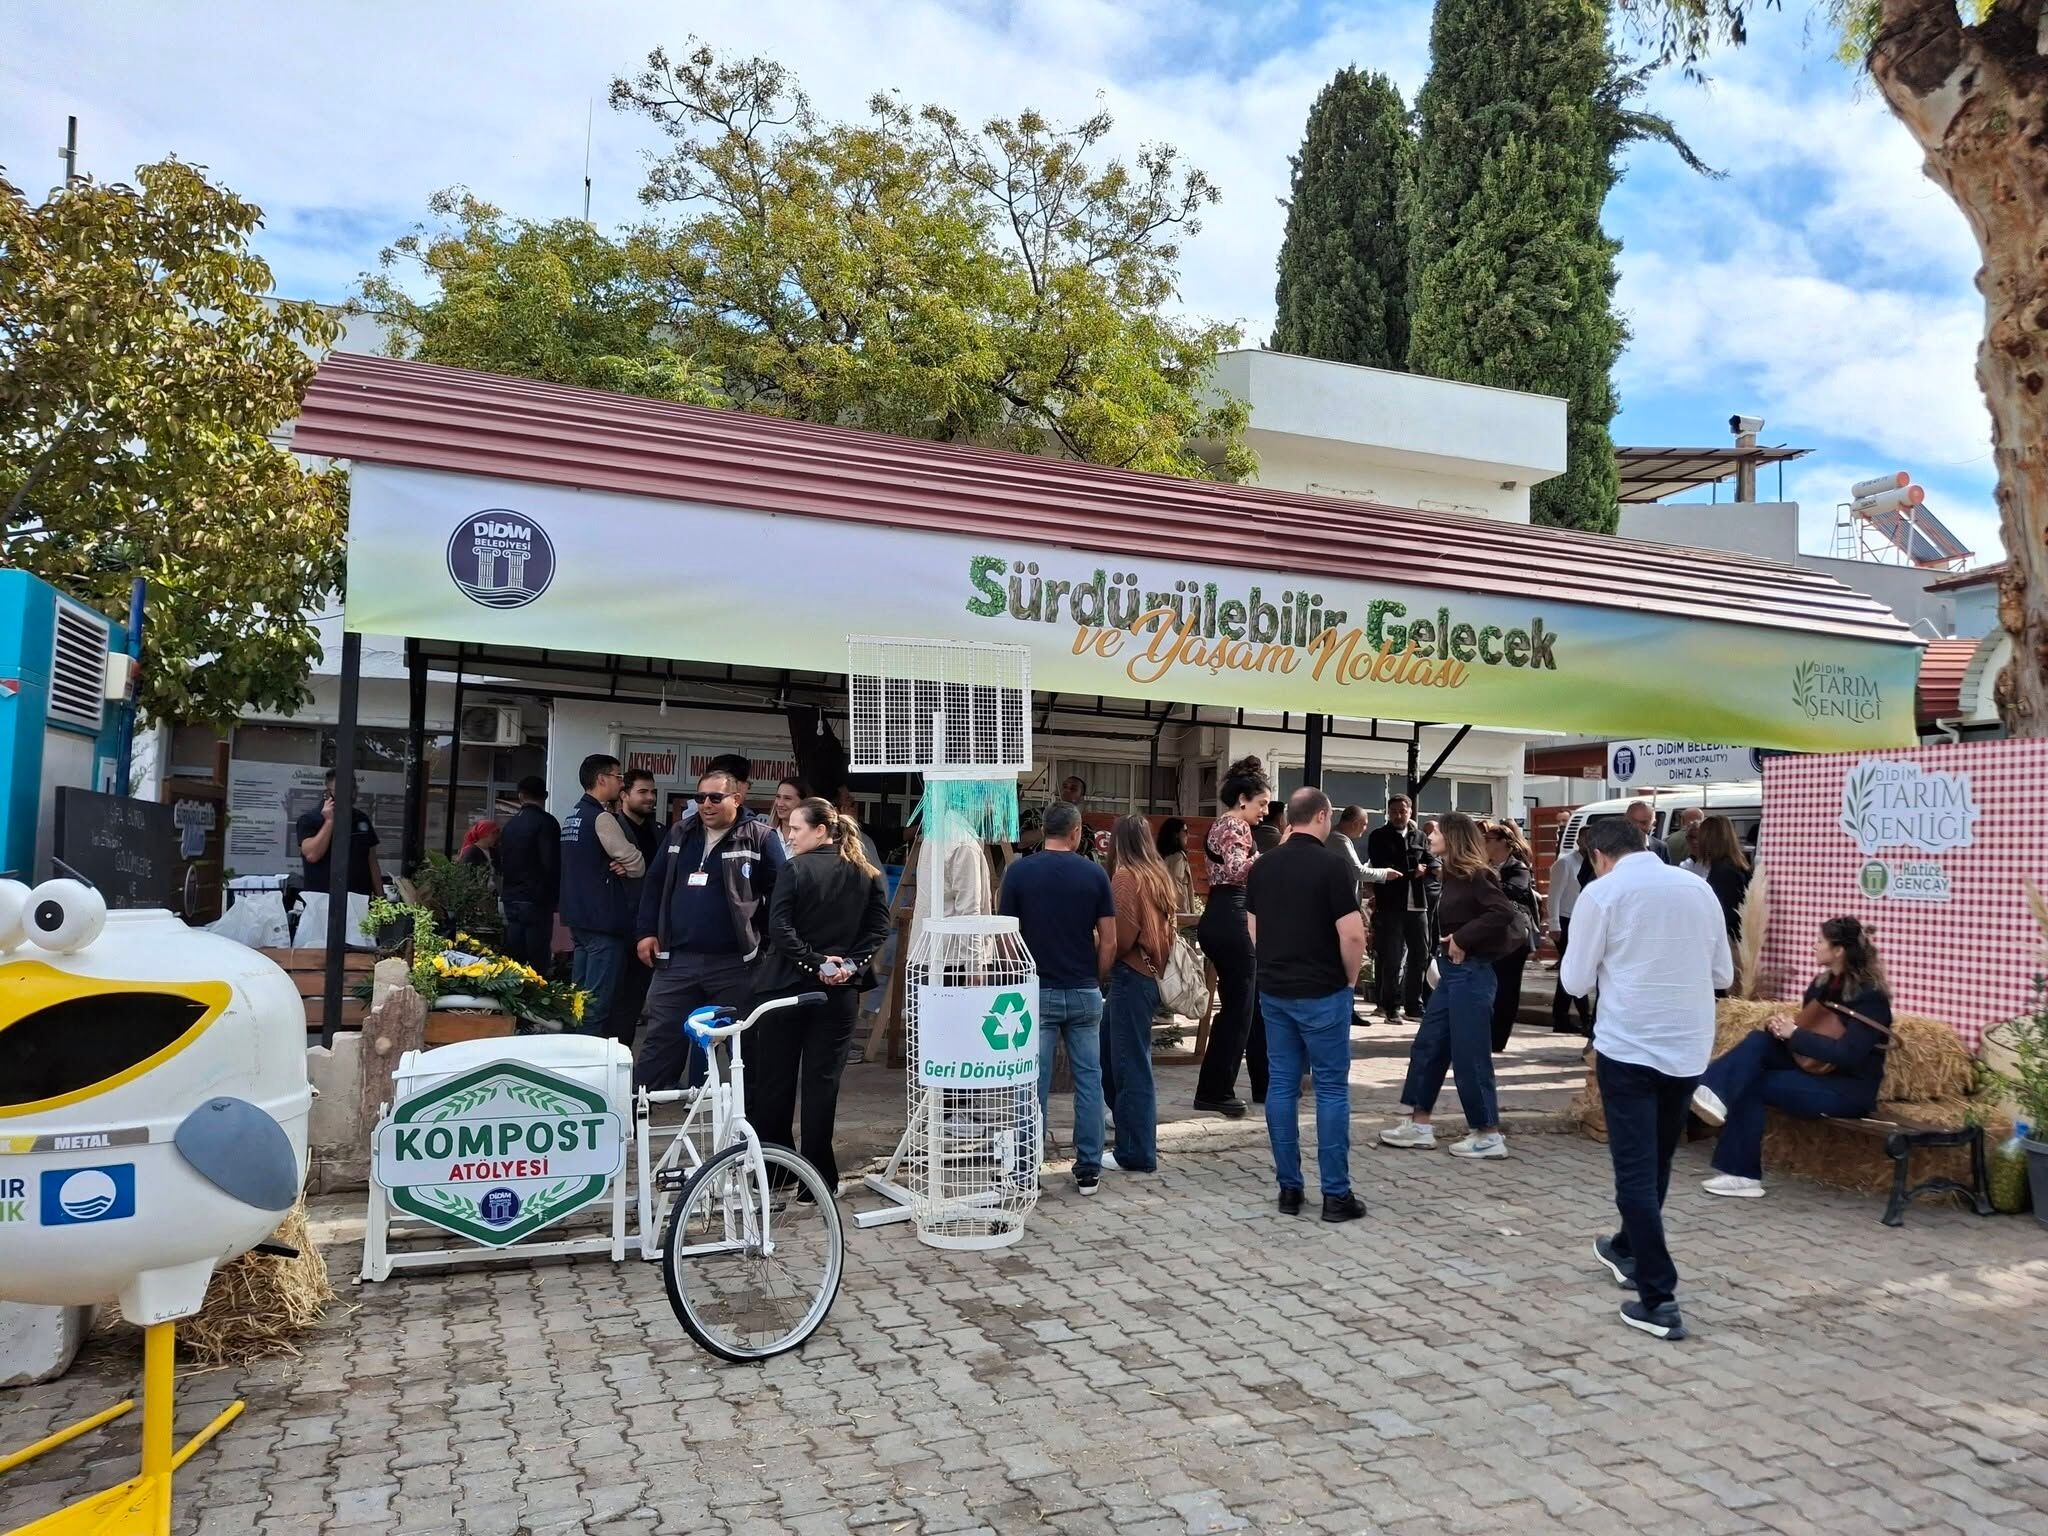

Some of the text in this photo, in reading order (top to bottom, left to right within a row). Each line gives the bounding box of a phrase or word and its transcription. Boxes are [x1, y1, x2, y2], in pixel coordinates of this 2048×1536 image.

[473, 521, 531, 541] DİDİM
[474, 537, 531, 551] BELEDİYESİ
[966, 554, 1558, 671] Sürdürülebilir Gelecek
[1071, 607, 1470, 689] ve Yaşam Noktası
[1815, 673, 1884, 703] TARIM
[1808, 695, 1881, 723] ŞENLİĞİ
[1639, 745, 1655, 757] T.C.
[1657, 742, 1685, 756] DİDİM
[1694, 766, 1712, 779] A.Ş.
[1875, 768, 1917, 781] DİDİM
[1875, 777, 1973, 813] TARIM
[1864, 812, 1968, 847] ŞENLİĞİ
[924, 1059, 956, 1078] Geri
[959, 1057, 1033, 1081] Dönüşüm
[54, 1133, 111, 1150] METAL
[395, 1119, 605, 1162] KOMPOST
[448, 1155, 549, 1181] ATÖLYESİ
